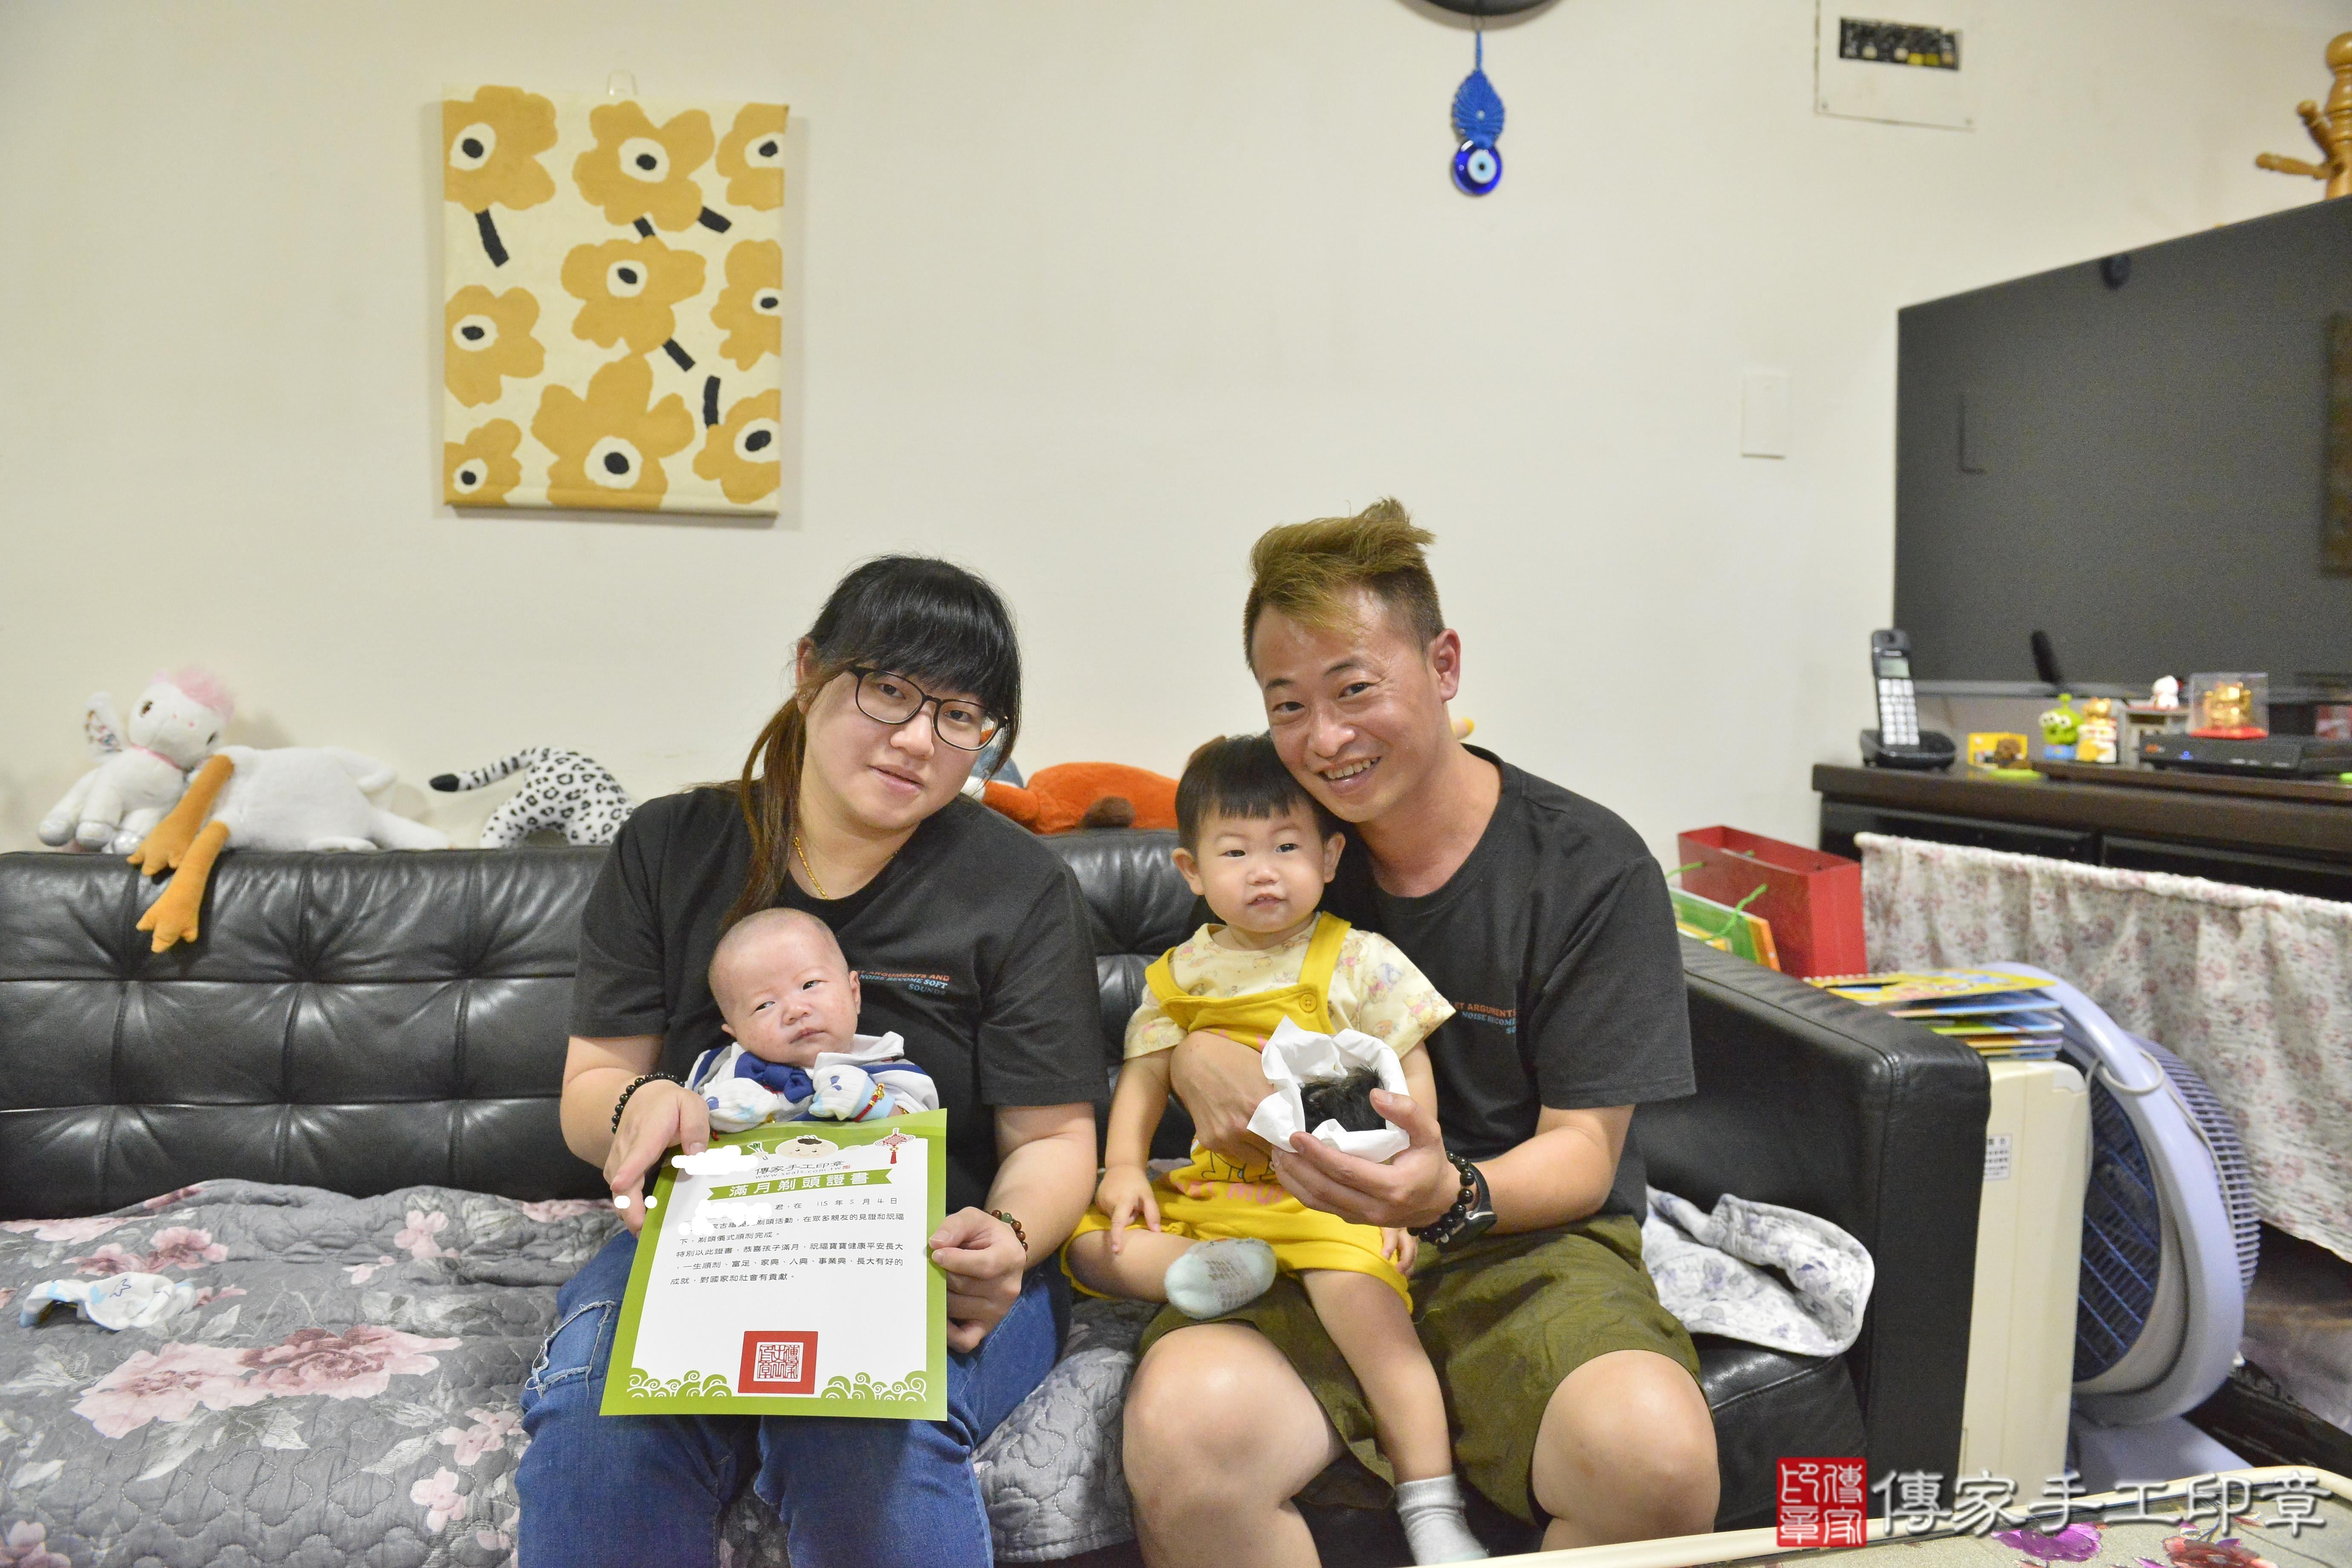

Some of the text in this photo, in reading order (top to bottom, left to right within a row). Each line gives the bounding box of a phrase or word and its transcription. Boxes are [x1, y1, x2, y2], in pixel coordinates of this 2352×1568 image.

[908, 983, 945, 995] SOUNDS
[923, 979, 948, 989] SOFT
[1450, 1002, 1465, 1010] ET
[1462, 1011, 1487, 1021] NOISE
[755, 1160, 845, 1175] 傳家手工印章
[755, 1166, 841, 1179] www.seals.com.tw
[729, 1172, 869, 1196] 滿月剃頭證書
